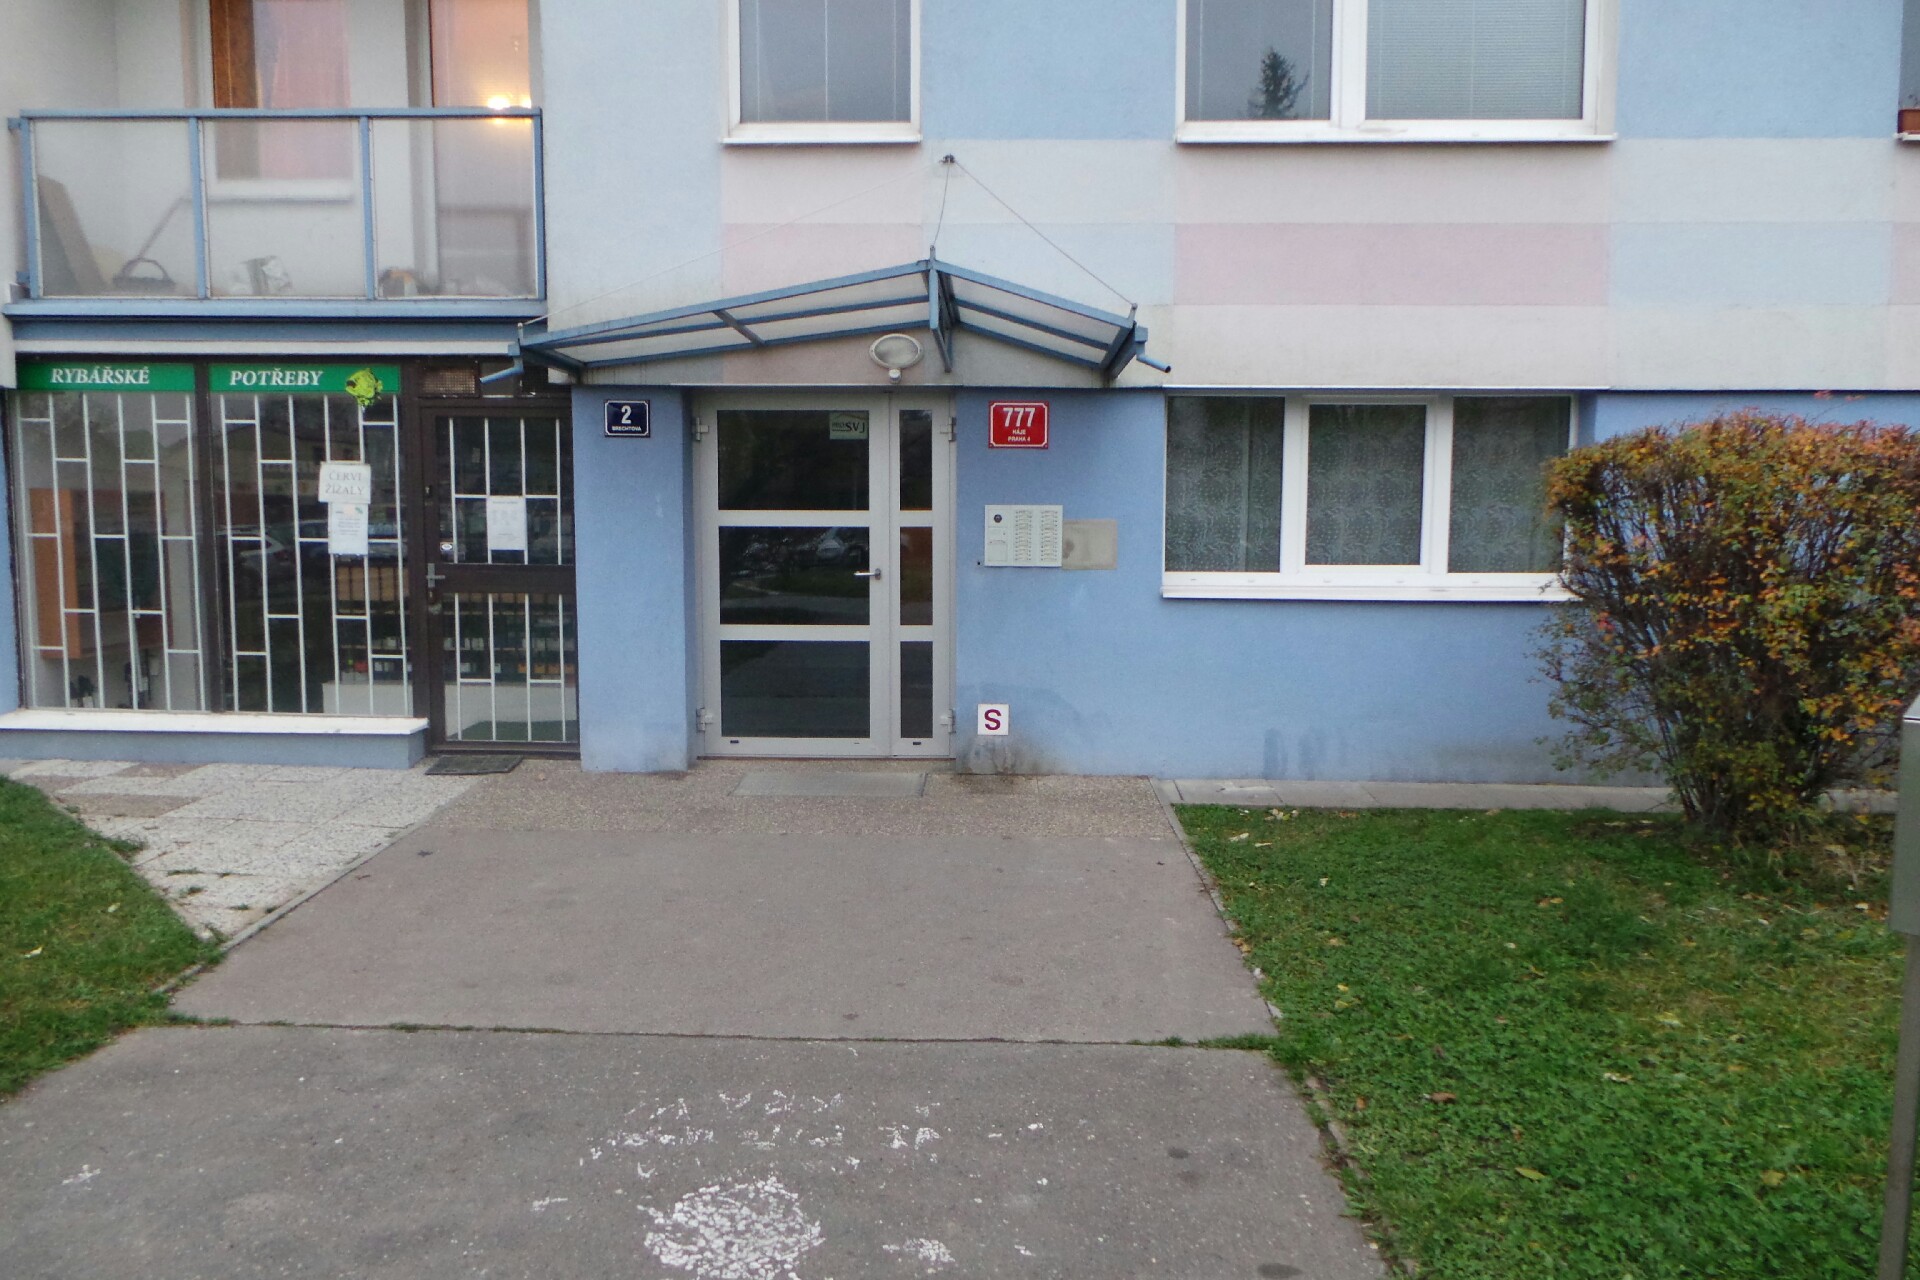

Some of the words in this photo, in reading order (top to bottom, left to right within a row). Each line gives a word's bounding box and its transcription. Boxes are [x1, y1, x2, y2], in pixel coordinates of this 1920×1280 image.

[50, 365, 150, 385] RYBÁŘSKÉ
[229, 366, 324, 386] POTŘEBY
[621, 405, 632, 424] 2
[1002, 407, 1036, 427] 777
[984, 708, 1002, 731] S
